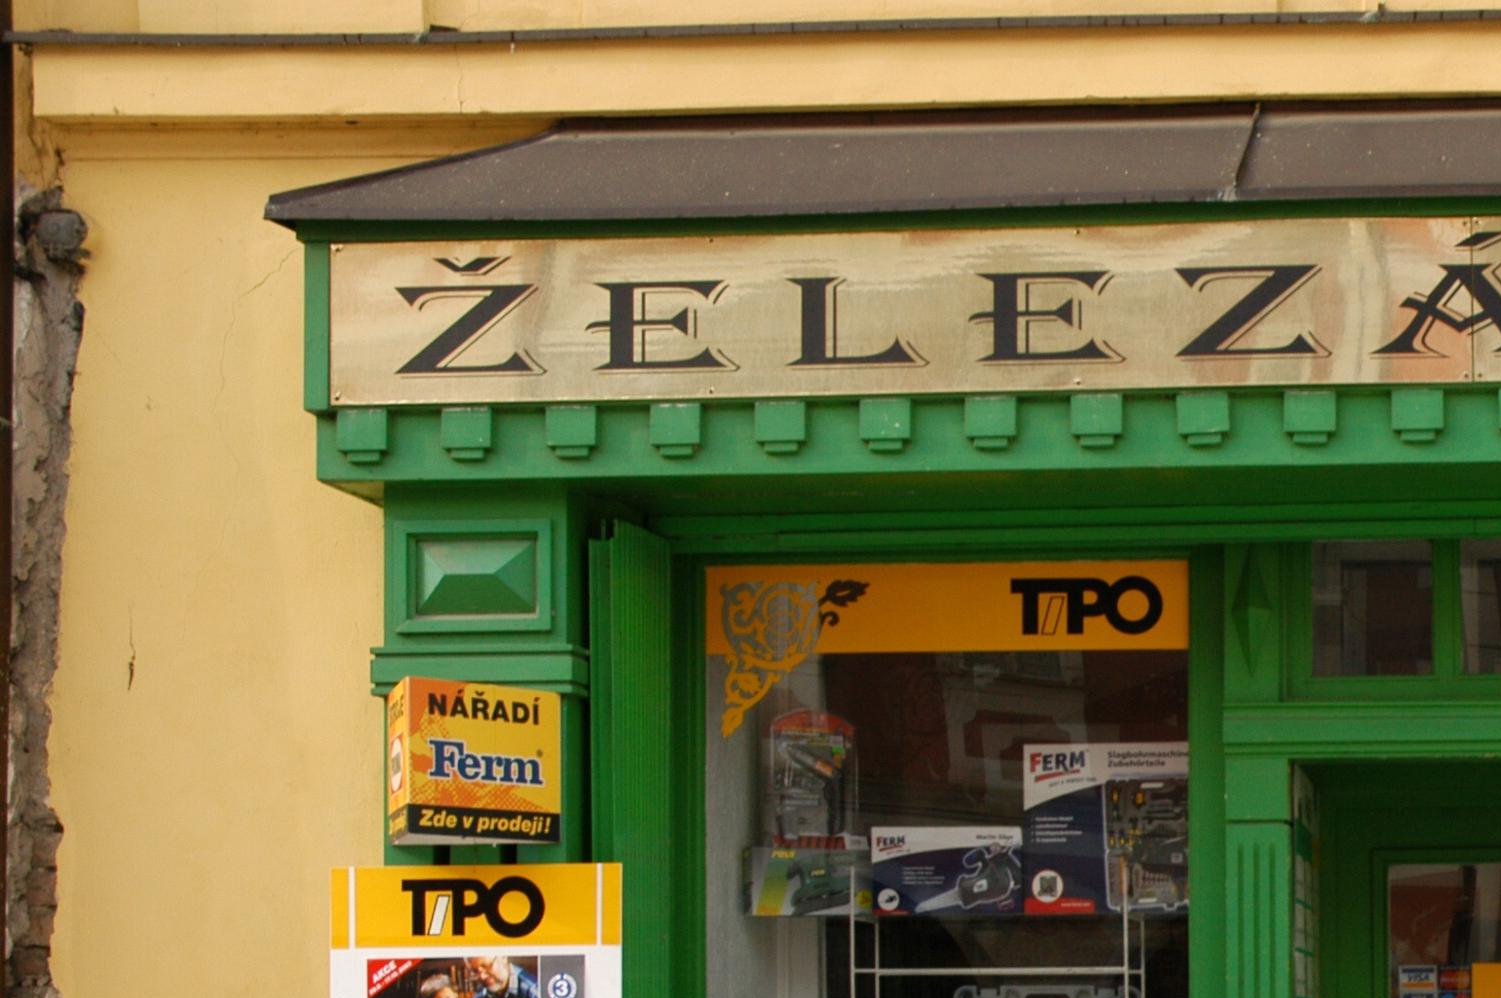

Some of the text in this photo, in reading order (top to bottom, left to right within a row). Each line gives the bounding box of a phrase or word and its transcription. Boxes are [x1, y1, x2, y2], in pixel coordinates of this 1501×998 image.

[1010, 575, 1163, 636] TIPO
[427, 689, 540, 725] NÁŘADÍ
[428, 739, 544, 785] Ferm
[1030, 751, 1085, 773] FERM
[419, 809, 551, 835] Zde v prodeji!
[876, 835, 907, 848] FERM
[402, 876, 545, 938] TIPO
[555, 980, 571, 997] 3
